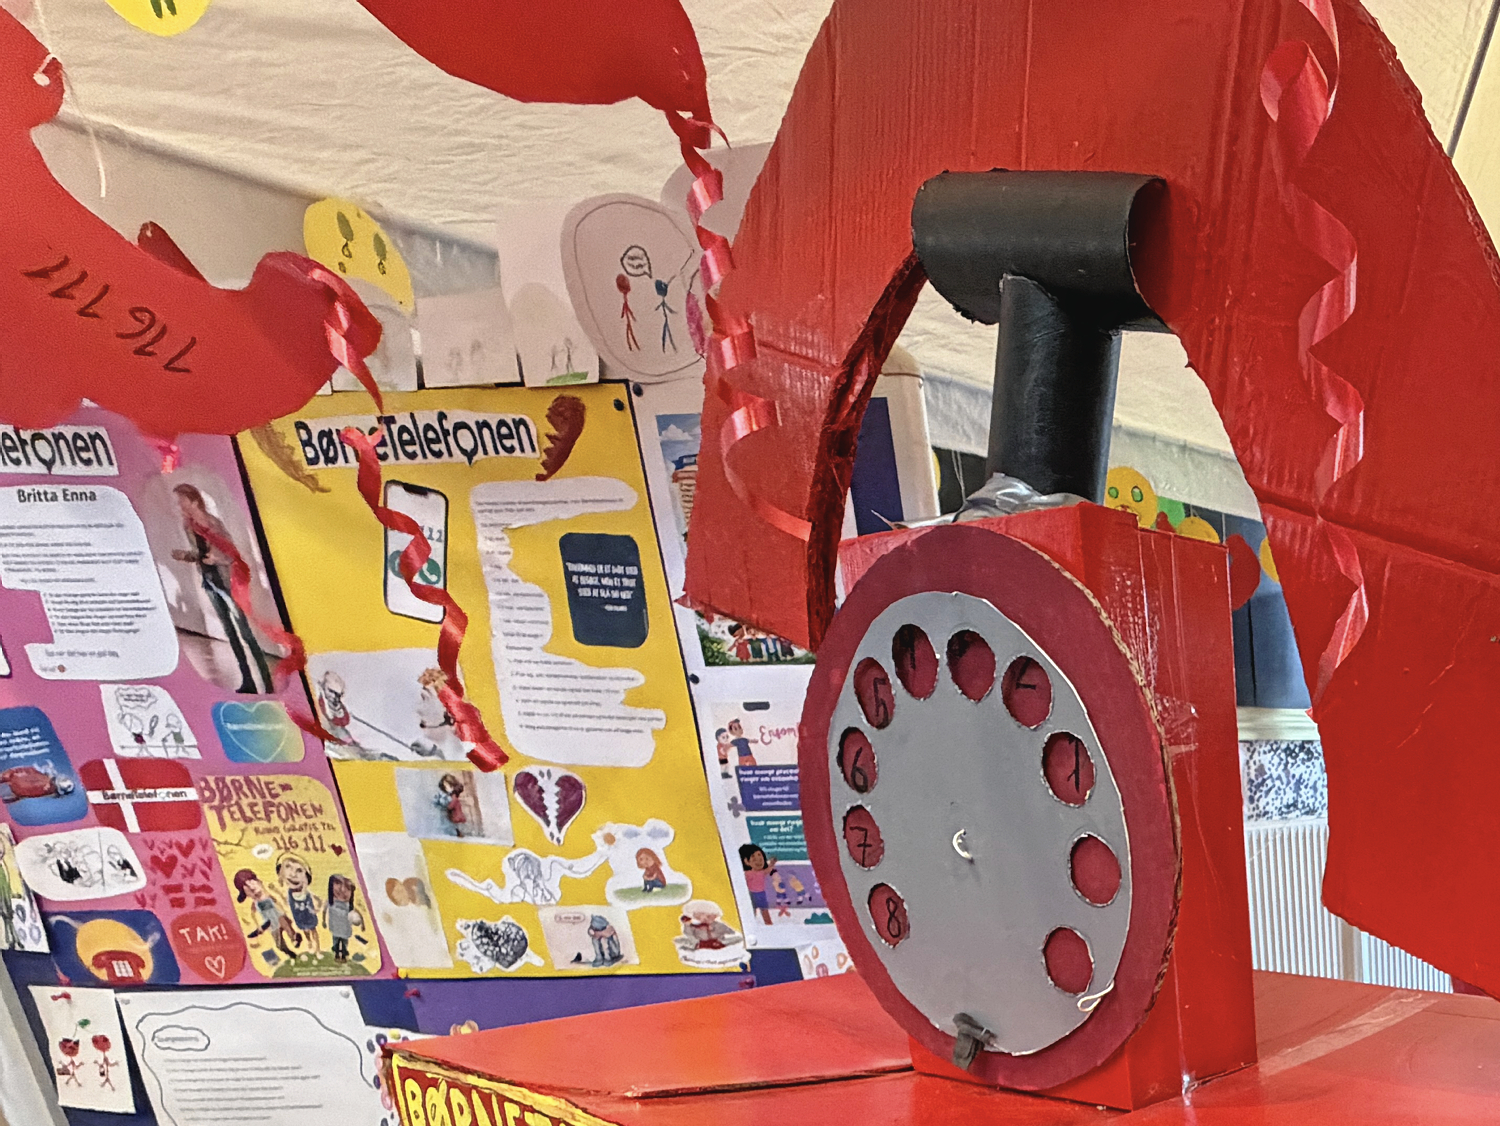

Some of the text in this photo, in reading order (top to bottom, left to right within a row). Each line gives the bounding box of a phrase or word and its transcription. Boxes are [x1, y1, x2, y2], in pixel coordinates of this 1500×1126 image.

[17, 488, 98, 503] Britta Enna
[851, 746, 869, 794] 6
[209, 800, 324, 832] TELEFONEN
[271, 832, 327, 853] 116 111
[849, 826, 873, 867] 7
[178, 923, 229, 945] TAK!
[886, 898, 901, 938] 8
